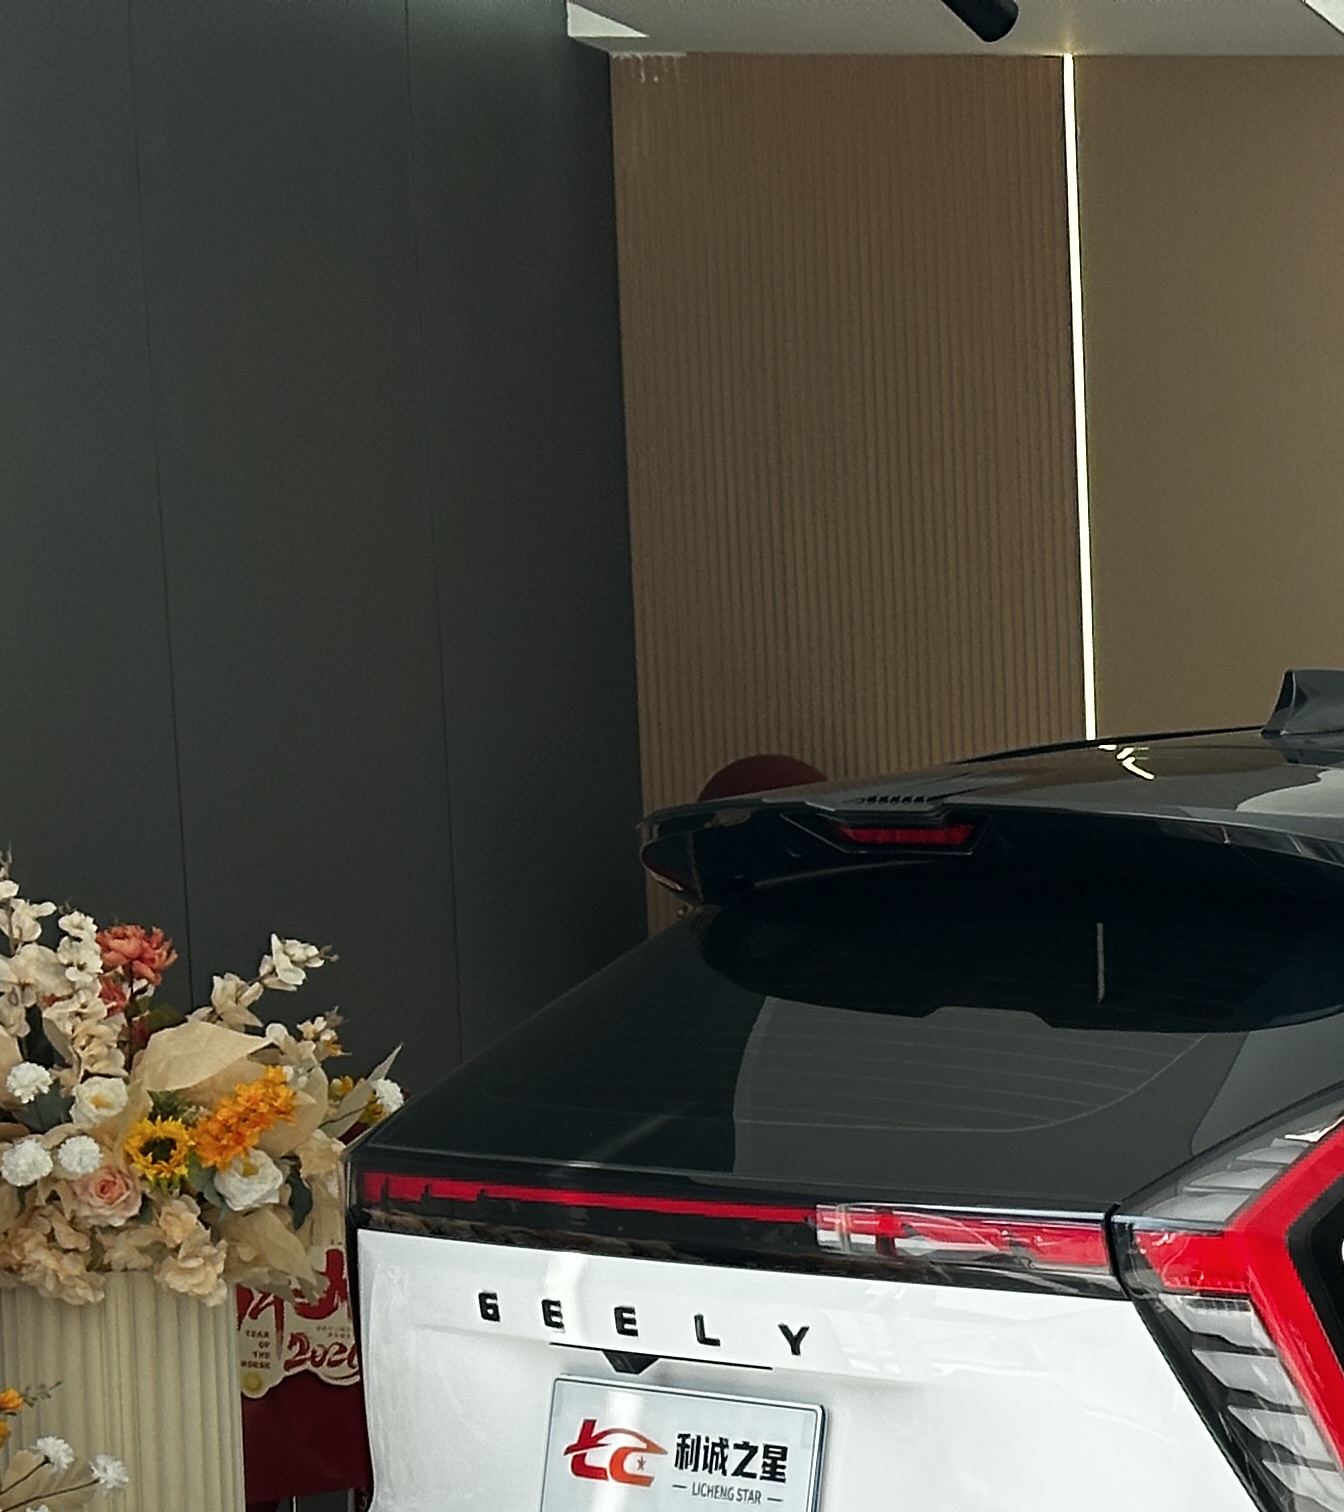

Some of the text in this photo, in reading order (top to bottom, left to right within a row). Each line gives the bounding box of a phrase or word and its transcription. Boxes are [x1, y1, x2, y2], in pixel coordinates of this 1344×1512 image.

[477, 1290, 810, 1357] GEELY
[674, 1432, 789, 1485] 利诚之星
[691, 1481, 762, 1505] LICHENG STAR
